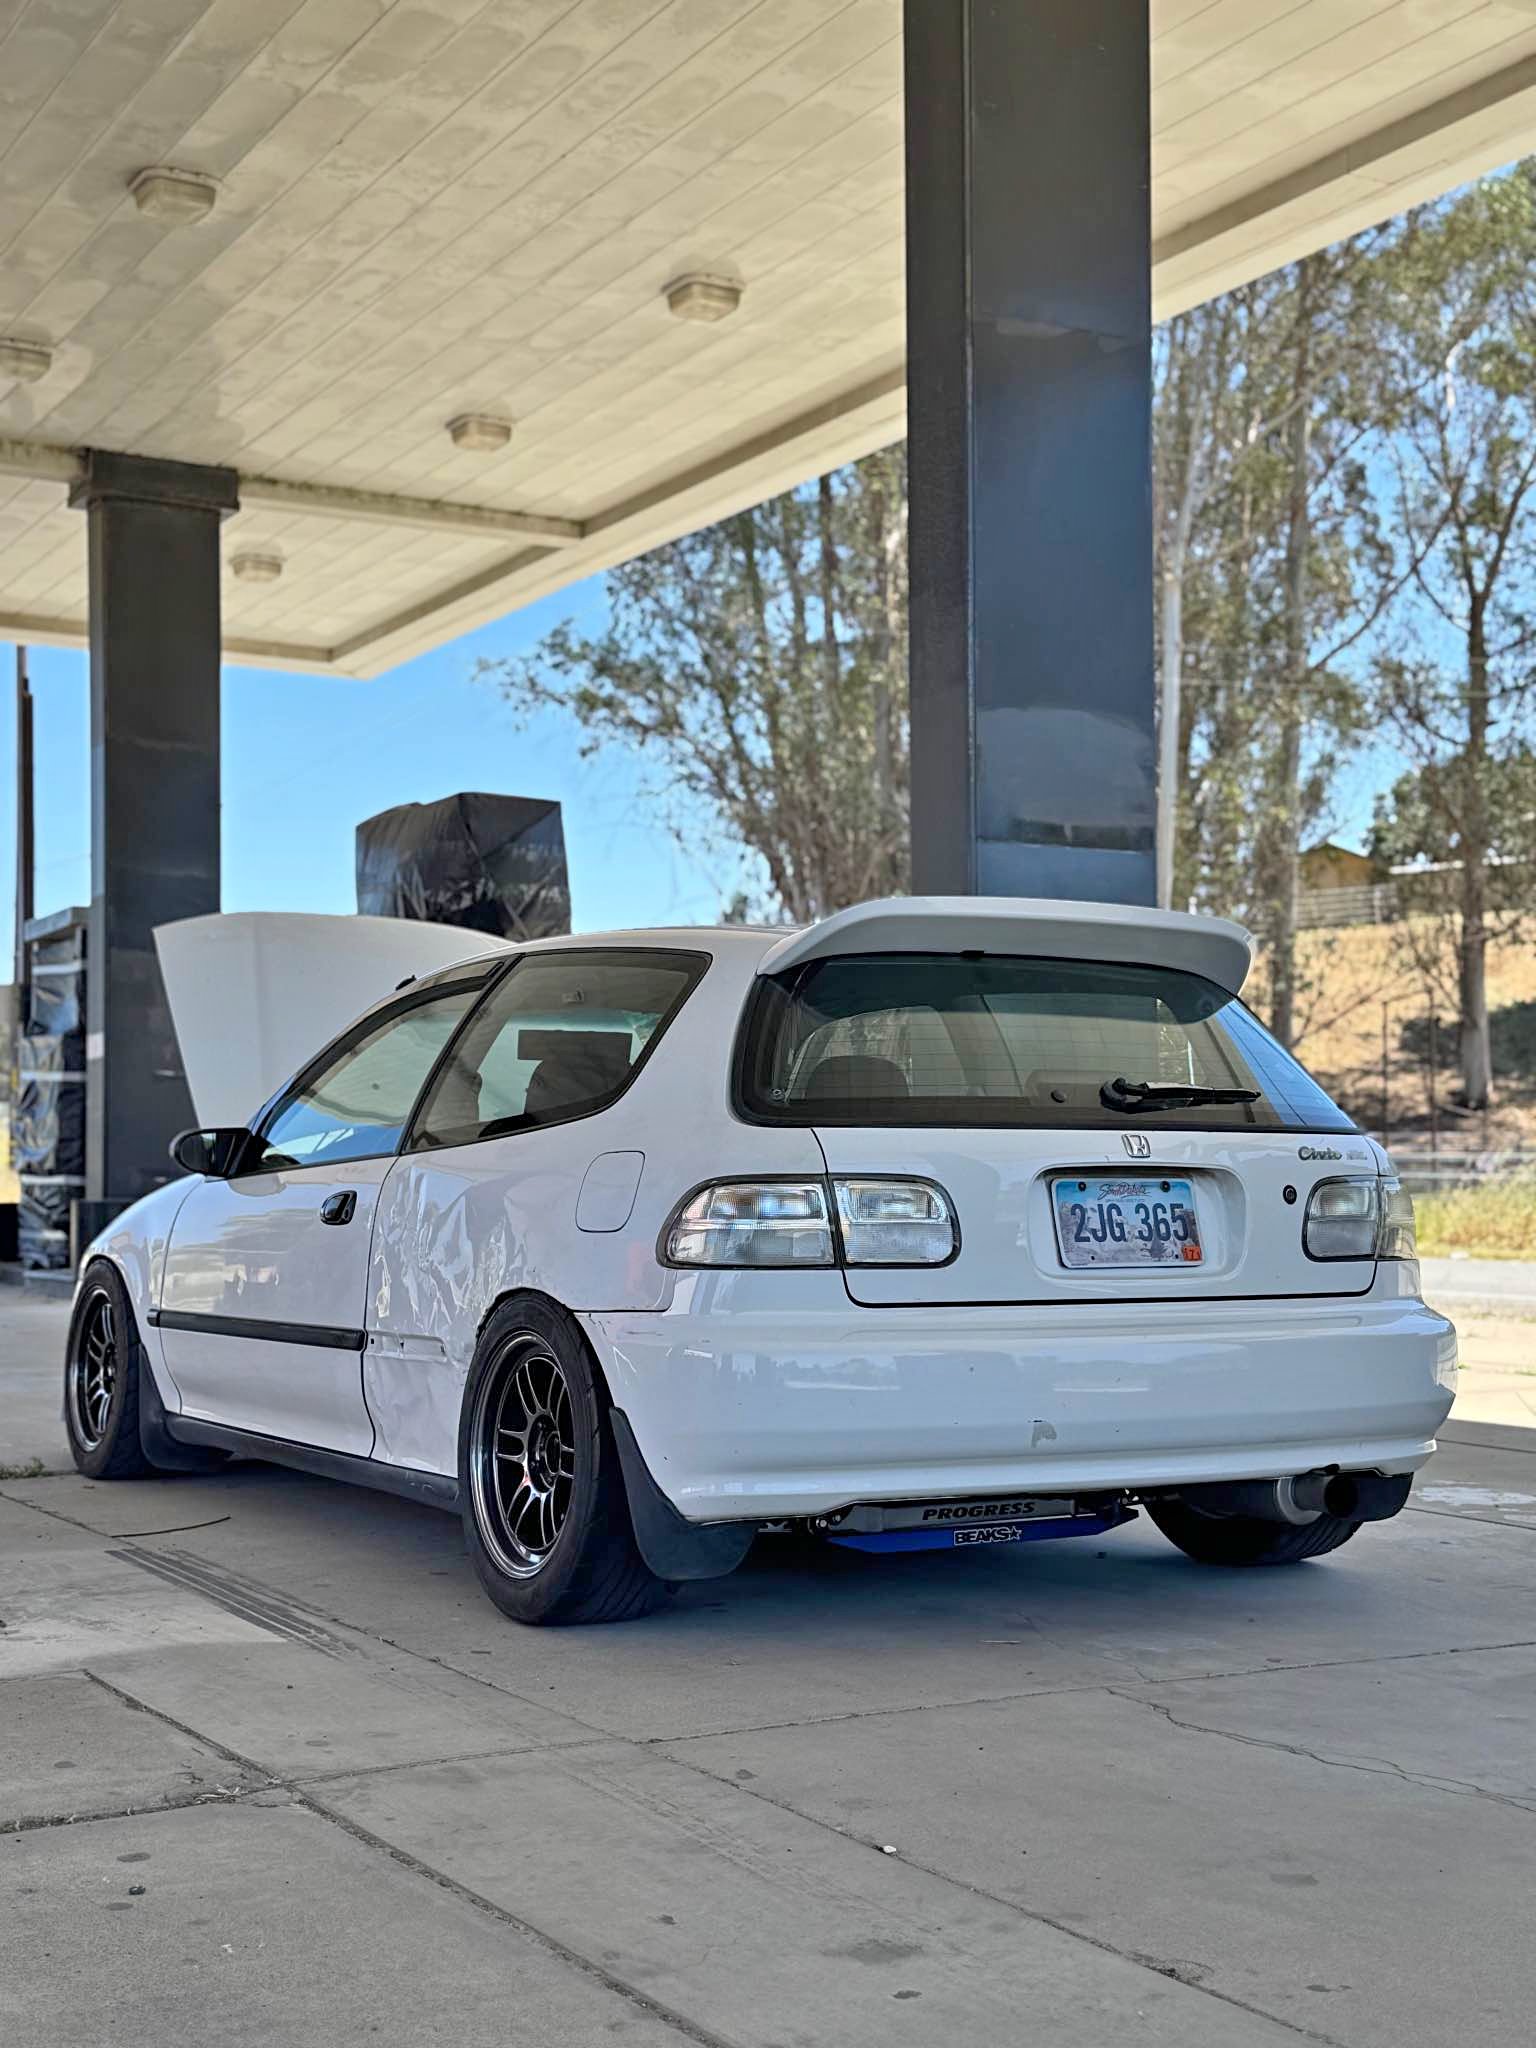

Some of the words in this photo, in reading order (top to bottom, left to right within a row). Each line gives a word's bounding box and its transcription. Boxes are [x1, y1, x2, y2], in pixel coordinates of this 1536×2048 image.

[1070, 1203, 1127, 1243] 2JG
[1135, 1203, 1189, 1242] 365
[922, 1502, 1035, 1520] PROGRESS
[954, 1527, 1011, 1545] BEAKS
